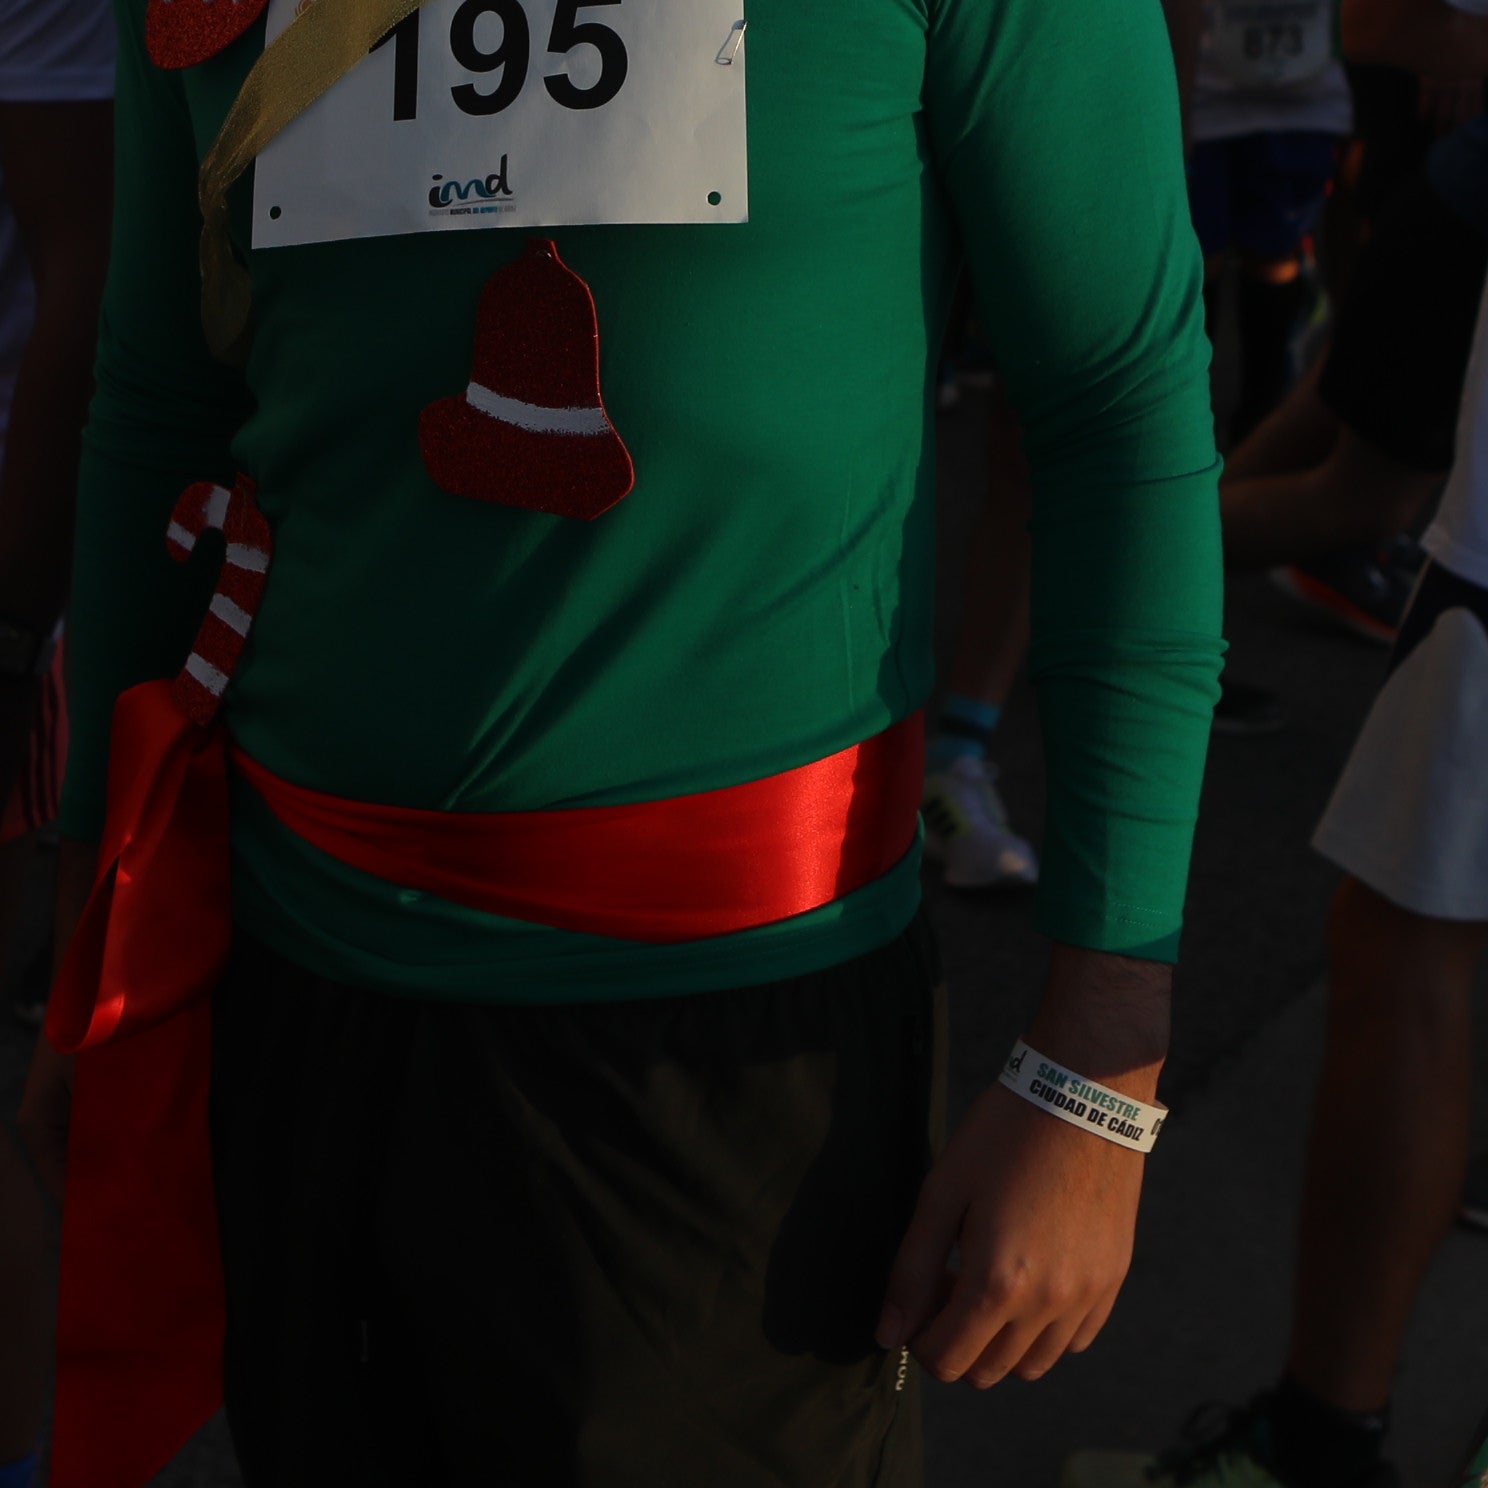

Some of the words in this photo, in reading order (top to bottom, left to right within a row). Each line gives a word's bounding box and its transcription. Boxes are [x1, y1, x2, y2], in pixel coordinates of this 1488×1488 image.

[429, 154, 513, 208] imd
[1028, 1078, 1087, 1118] CIUDAD
[1086, 1108, 1109, 1127] DE
[1107, 1116, 1144, 1141] CÁDIZ
[1036, 1062, 1069, 1089] SAN
[1068, 1079, 1142, 1122] SILVESTRE
